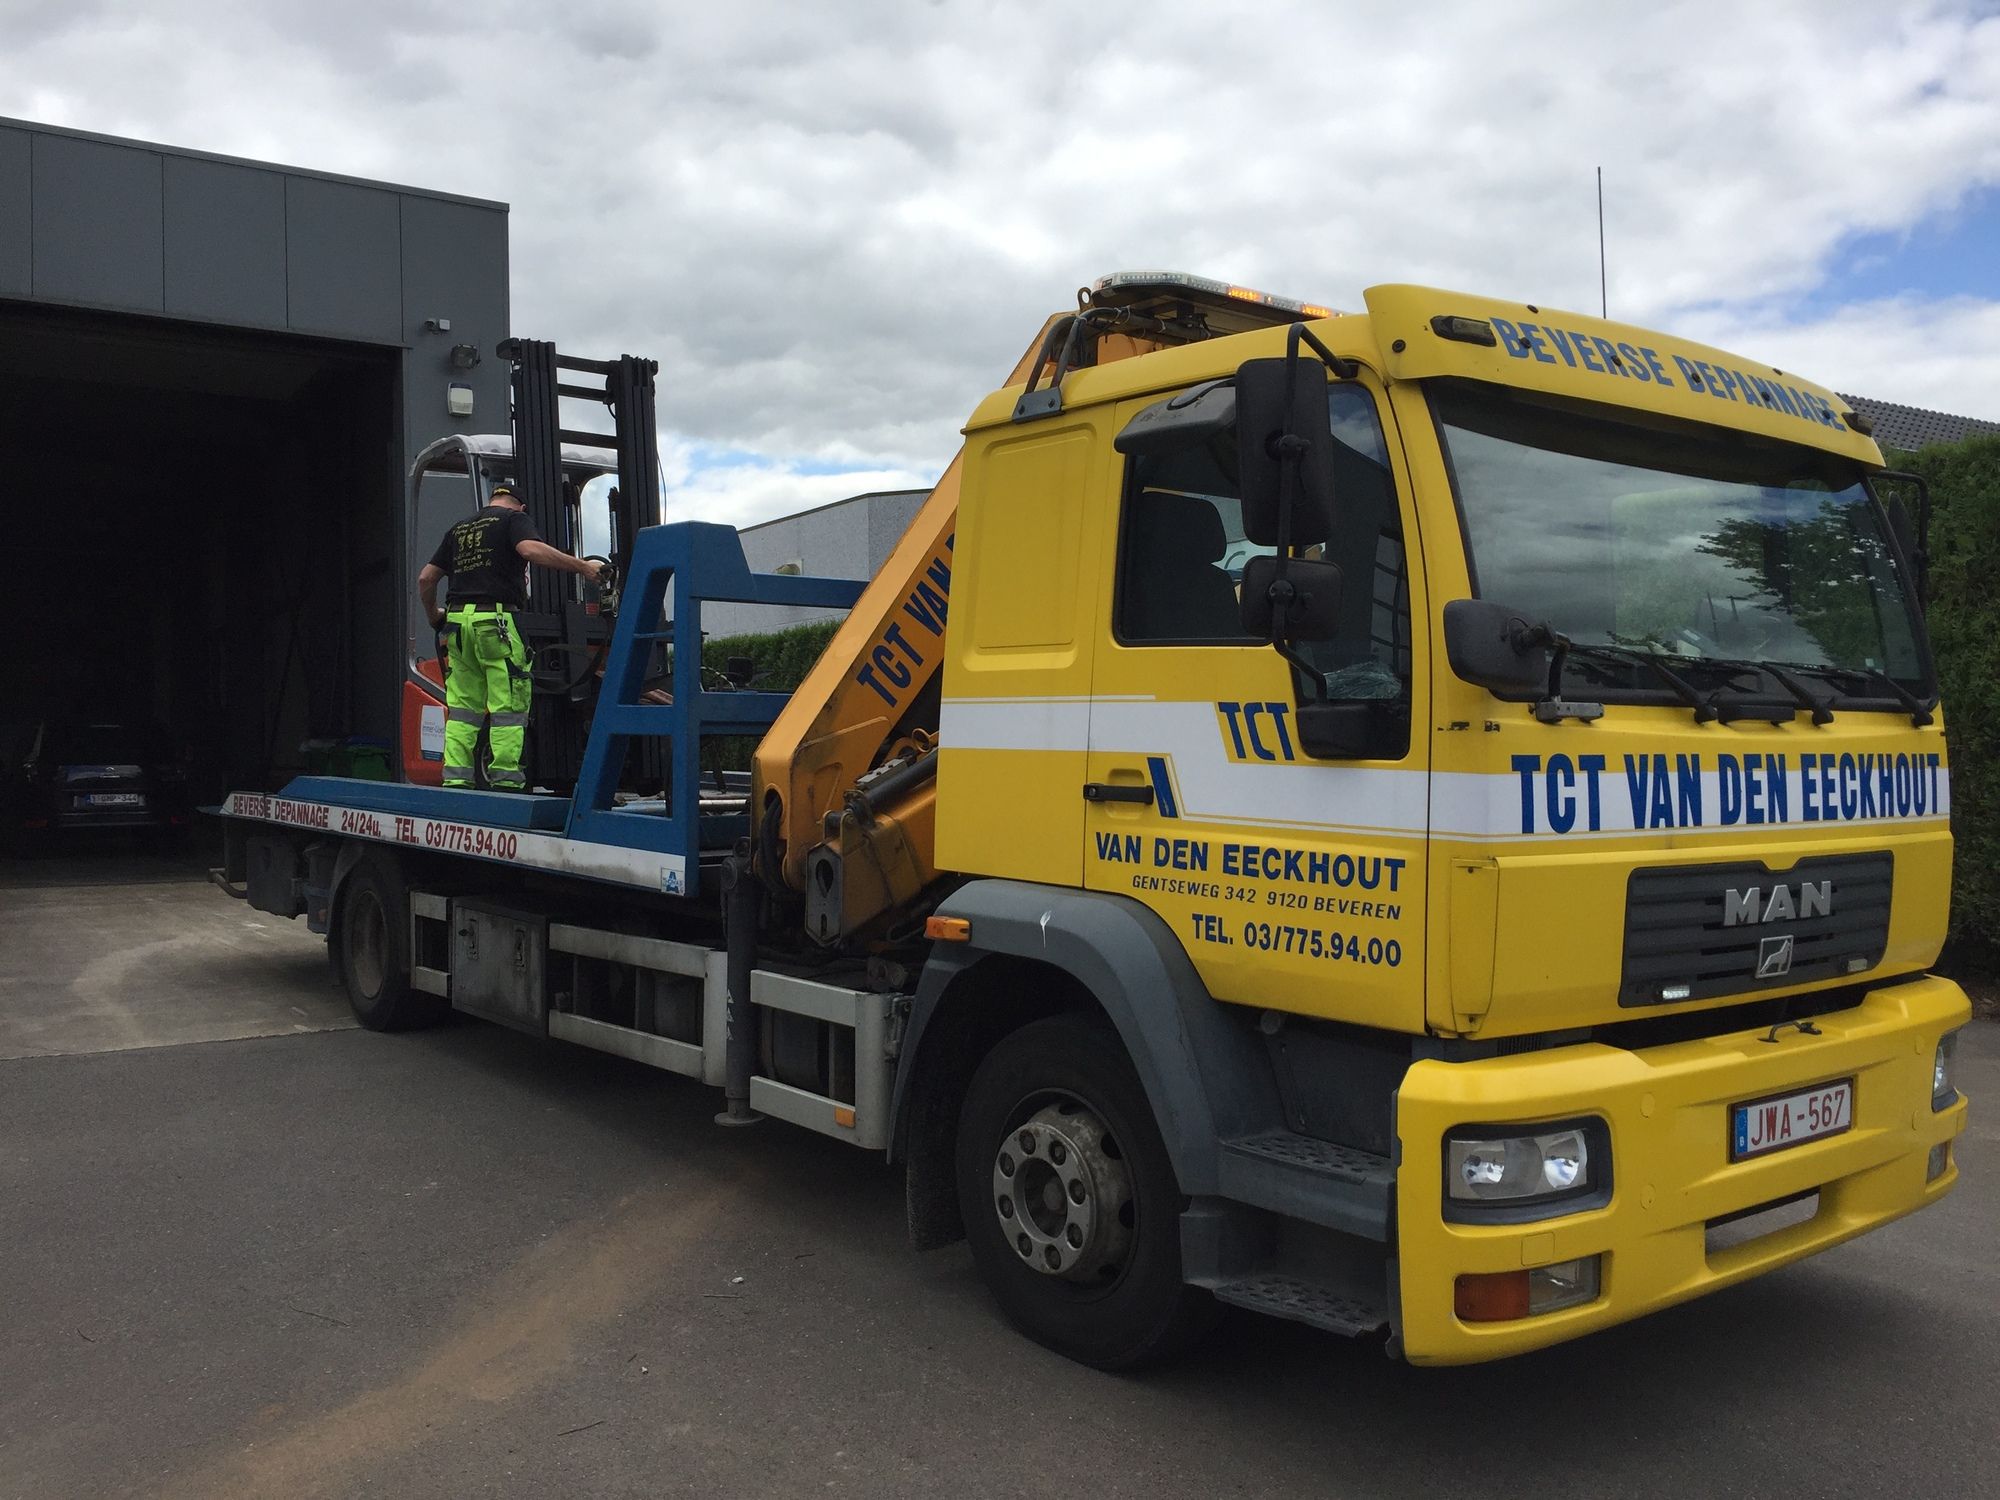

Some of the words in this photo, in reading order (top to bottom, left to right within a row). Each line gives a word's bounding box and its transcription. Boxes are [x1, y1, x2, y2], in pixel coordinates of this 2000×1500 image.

[1490, 317, 1675, 387] BEVERSE
[1672, 354, 1848, 432] DEPANNAGE
[856, 621, 924, 708] TCT
[1217, 701, 1295, 761] TCT
[1511, 753, 1606, 834] TCT
[1624, 753, 1703, 830] VAN
[1717, 753, 1788, 826] DEN
[1800, 752, 1940, 822] EECKHOUT
[233, 795, 271, 819] BEVERSE
[275, 800, 329, 828] DEPANNAGE
[395, 817, 419, 843] TEL.
[425, 822, 517, 859] 03/775.94.00
[1095, 832, 1141, 863] VAN
[1154, 838, 1208, 871] DEN
[1222, 843, 1406, 892] EECKHOUT
[1132, 875, 1220, 898] GENTSEWEG
[1225, 886, 1257, 903] 342
[1266, 891, 1308, 909] 9120
[1314, 896, 1401, 920] BEVEREN
[1723, 880, 1832, 927] MAN
[1192, 913, 1234, 944] TEL.
[1244, 921, 1402, 967] 03/775.94.00
[1751, 1090, 1845, 1146] JWA-567
